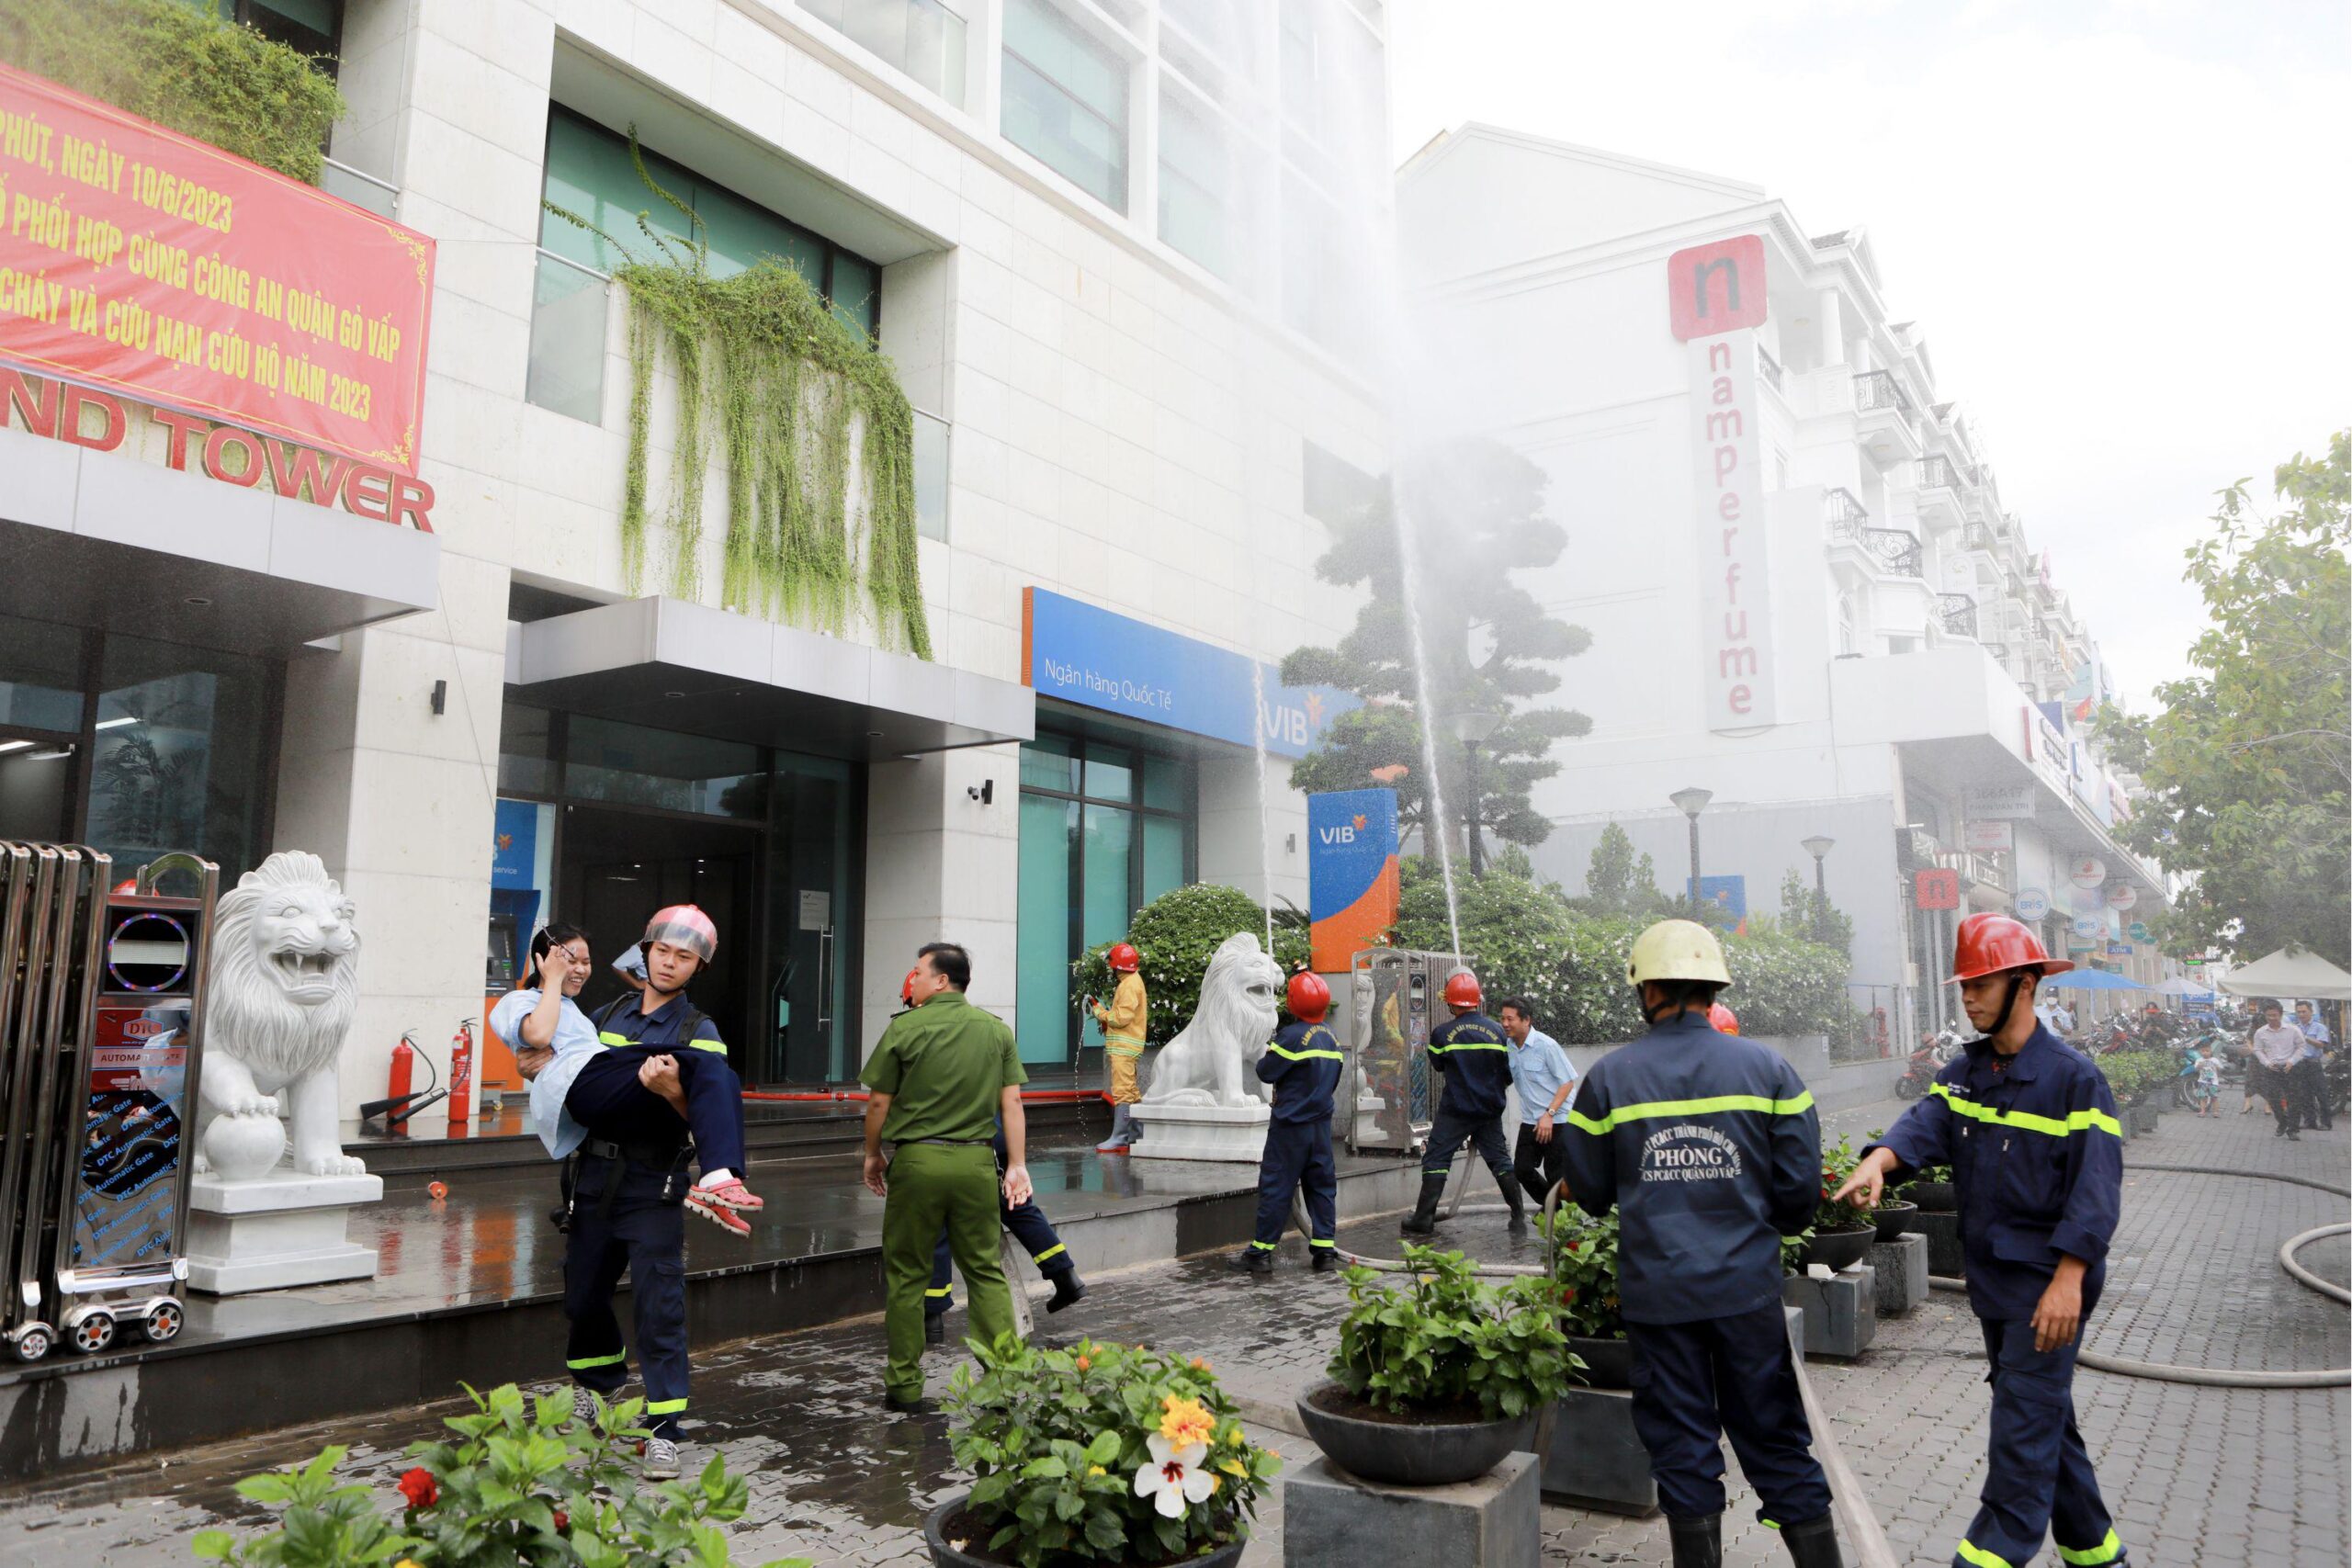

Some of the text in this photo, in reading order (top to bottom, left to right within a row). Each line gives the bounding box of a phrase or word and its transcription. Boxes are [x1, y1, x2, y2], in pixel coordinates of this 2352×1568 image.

[62, 134, 125, 194] NGÀY
[131, 161, 233, 234] 10/6/2023
[13, 191, 71, 253] PHỐI
[75, 214, 123, 273] HỢP
[129, 230, 188, 289] CÙNG
[194, 252, 251, 310] CÔNG
[255, 276, 283, 321] AN
[287, 290, 336, 344] QUẬN
[339, 304, 364, 352] GÒ
[368, 312, 401, 364] VẤP
[1692, 254, 1742, 320] n
[0, 267, 372, 423] CHÁY VÀ CỨU NẠN CỨU HỘ NĂM 2023
[150, 407, 436, 534] TOWER
[1706, 339, 1758, 716] namperfume
[1046, 658, 1172, 712] Ngân hàng Quốc Tế
[1262, 702, 1308, 746] VIB
[1319, 826, 1355, 844] VIB
[130, 1023, 158, 1034] DTC
[97, 1151, 114, 1167] DTC
[115, 1127, 154, 1155] Automatic
[154, 1115, 173, 1130] Gate
[163, 1134, 180, 1148] DTC
[1654, 1144, 1723, 1168] PHÒNG
[95, 1164, 135, 1193] Automatic
[135, 1152, 154, 1166] Gate
[134, 1163, 174, 1191] Automatic
